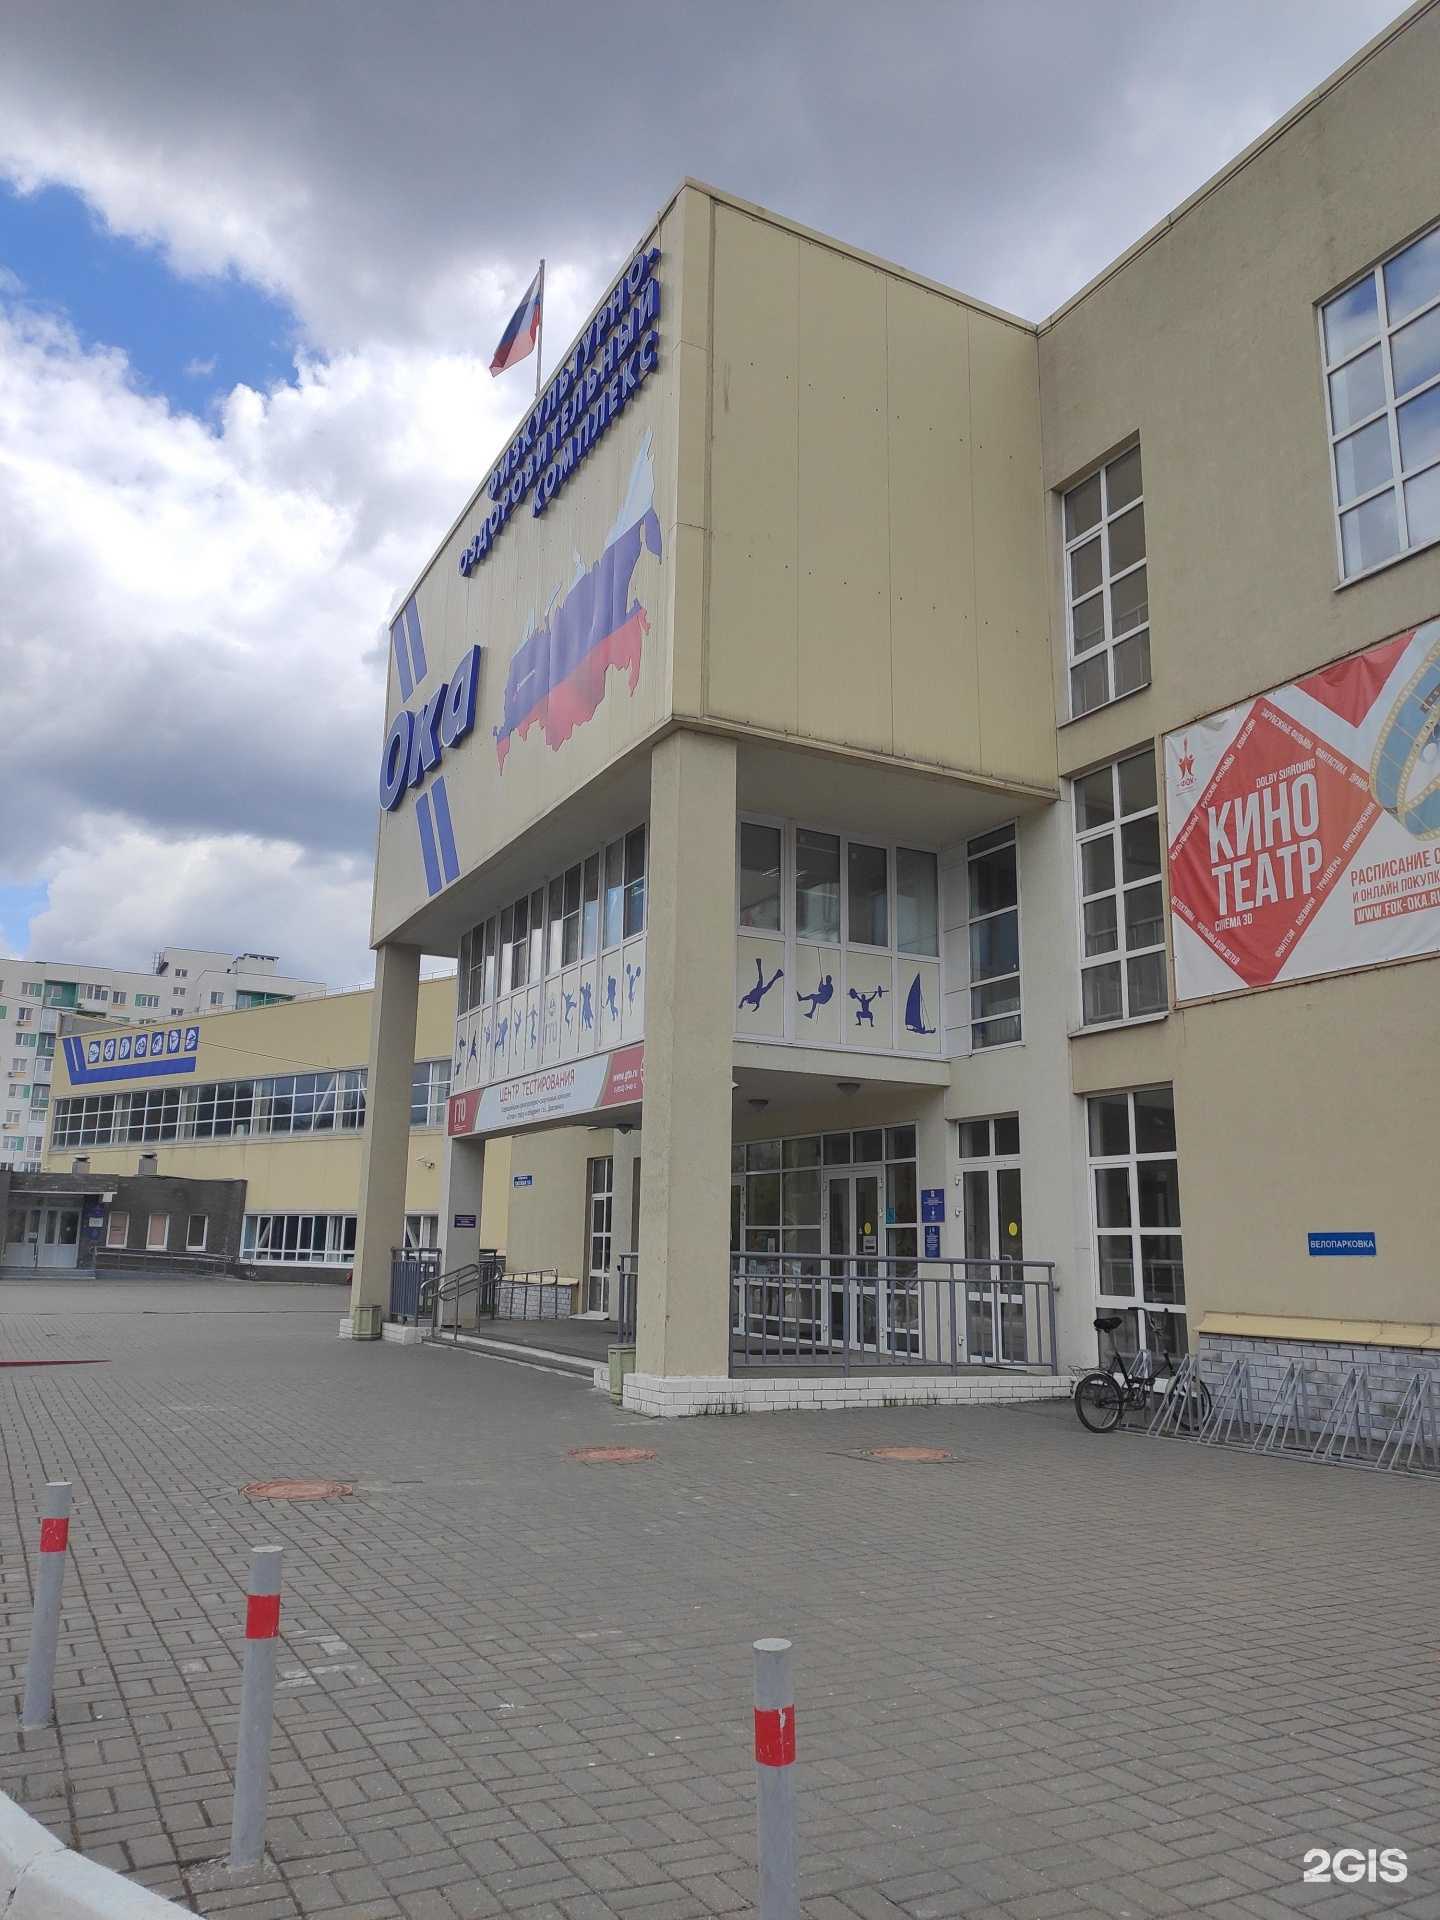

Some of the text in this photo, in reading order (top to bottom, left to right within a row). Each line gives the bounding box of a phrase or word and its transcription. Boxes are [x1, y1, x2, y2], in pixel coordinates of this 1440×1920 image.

[458, 277, 661, 578] ОЗДОРОВИТЕЛЬНЫЙ
[531, 329, 659, 519] КОМПЛЕКС
[1279, 758, 1316, 781] SURROUND
[1207, 773, 1320, 864] КИНО
[1211, 838, 1323, 916] ТЕАТР
[1350, 849, 1432, 887] РАСПИСАНИЕ
[1352, 891, 1360, 905] И
[1360, 880, 1400, 902] ОНЛАЙН
[499, 1068, 576, 1103] ЦЕНТР ТЕСТИРОВАНИЯ
[1310, 1239, 1375, 1249] ВЕЛОПАРКОВКА
